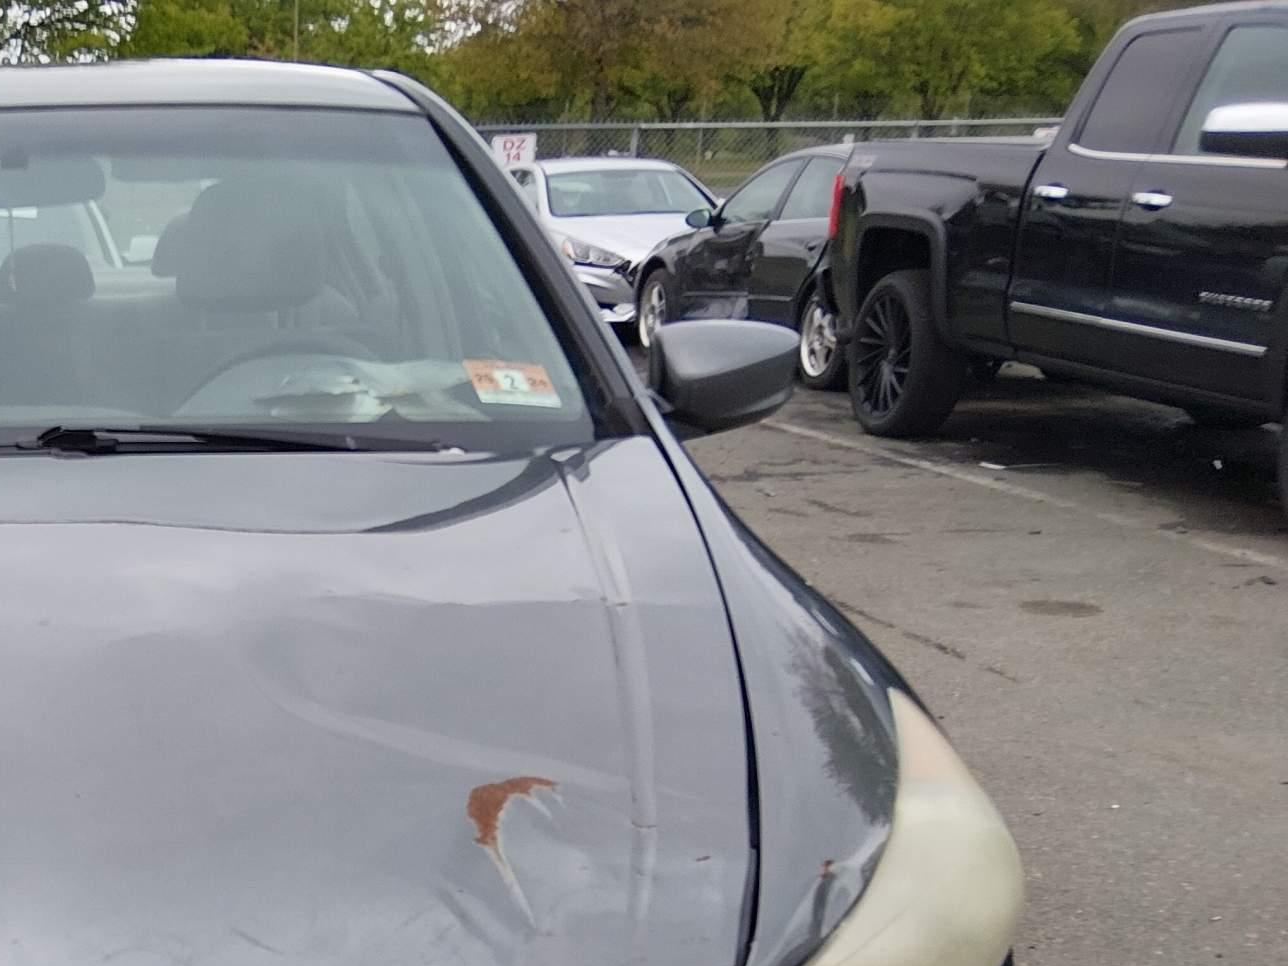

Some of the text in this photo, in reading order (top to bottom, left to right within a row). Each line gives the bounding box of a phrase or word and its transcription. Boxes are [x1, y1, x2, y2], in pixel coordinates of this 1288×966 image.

[503, 138, 527, 151] DZ
[505, 151, 522, 163] 14
[503, 373, 521, 391] 2
